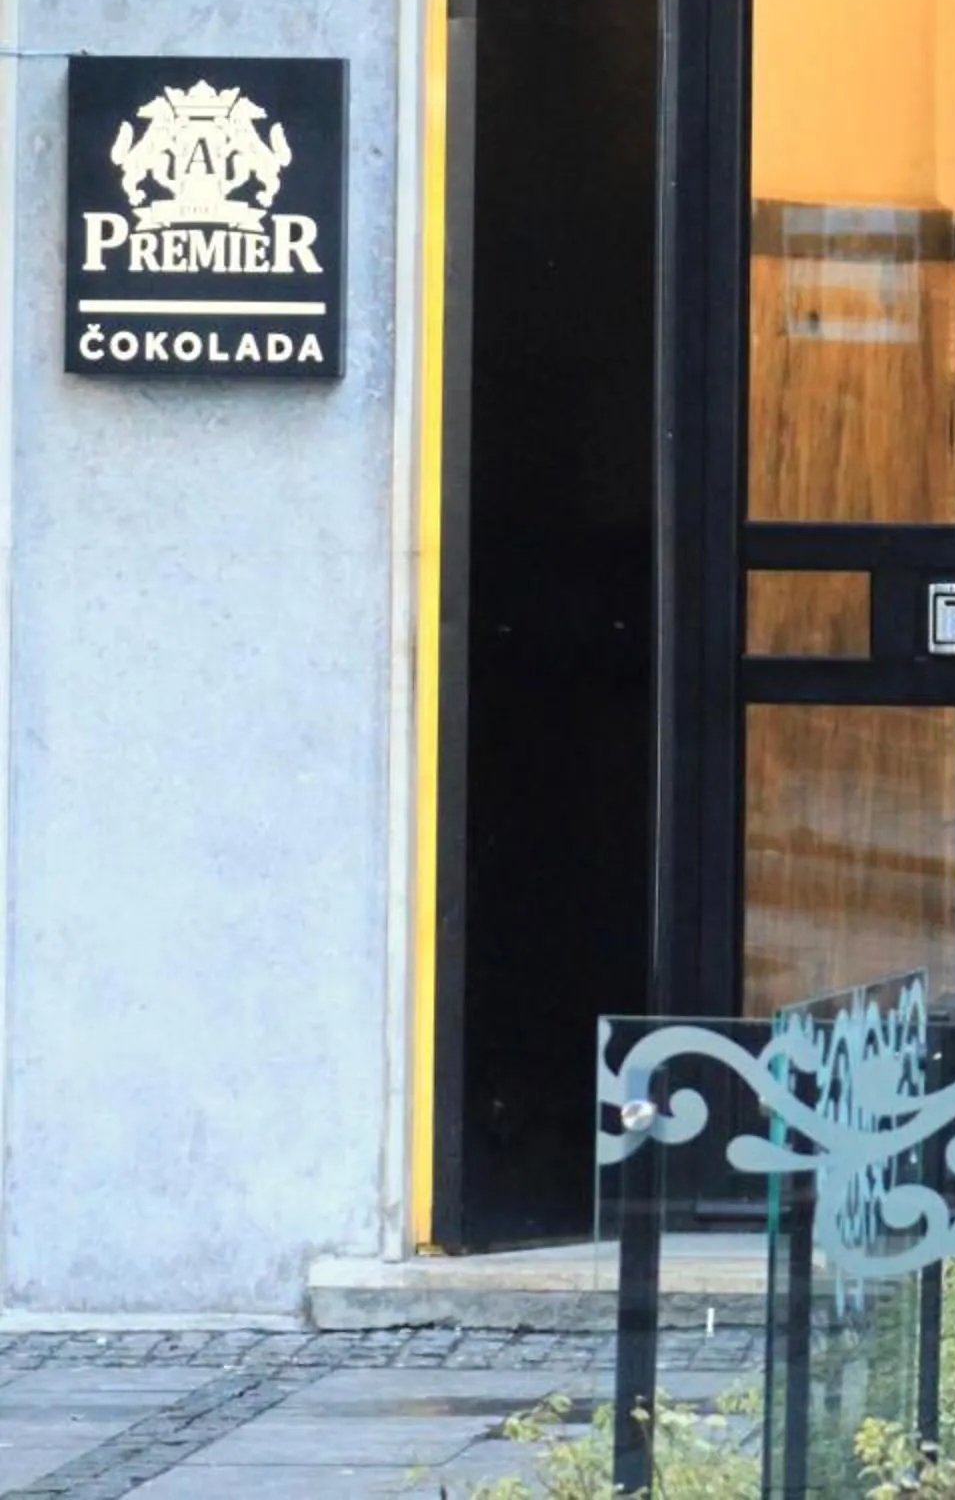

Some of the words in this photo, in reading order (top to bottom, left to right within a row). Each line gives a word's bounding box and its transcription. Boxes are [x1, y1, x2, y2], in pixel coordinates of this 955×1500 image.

[184, 137, 215, 175] A
[82, 211, 323, 274] PREMIER
[79, 324, 323, 362] ČOKOLADA
